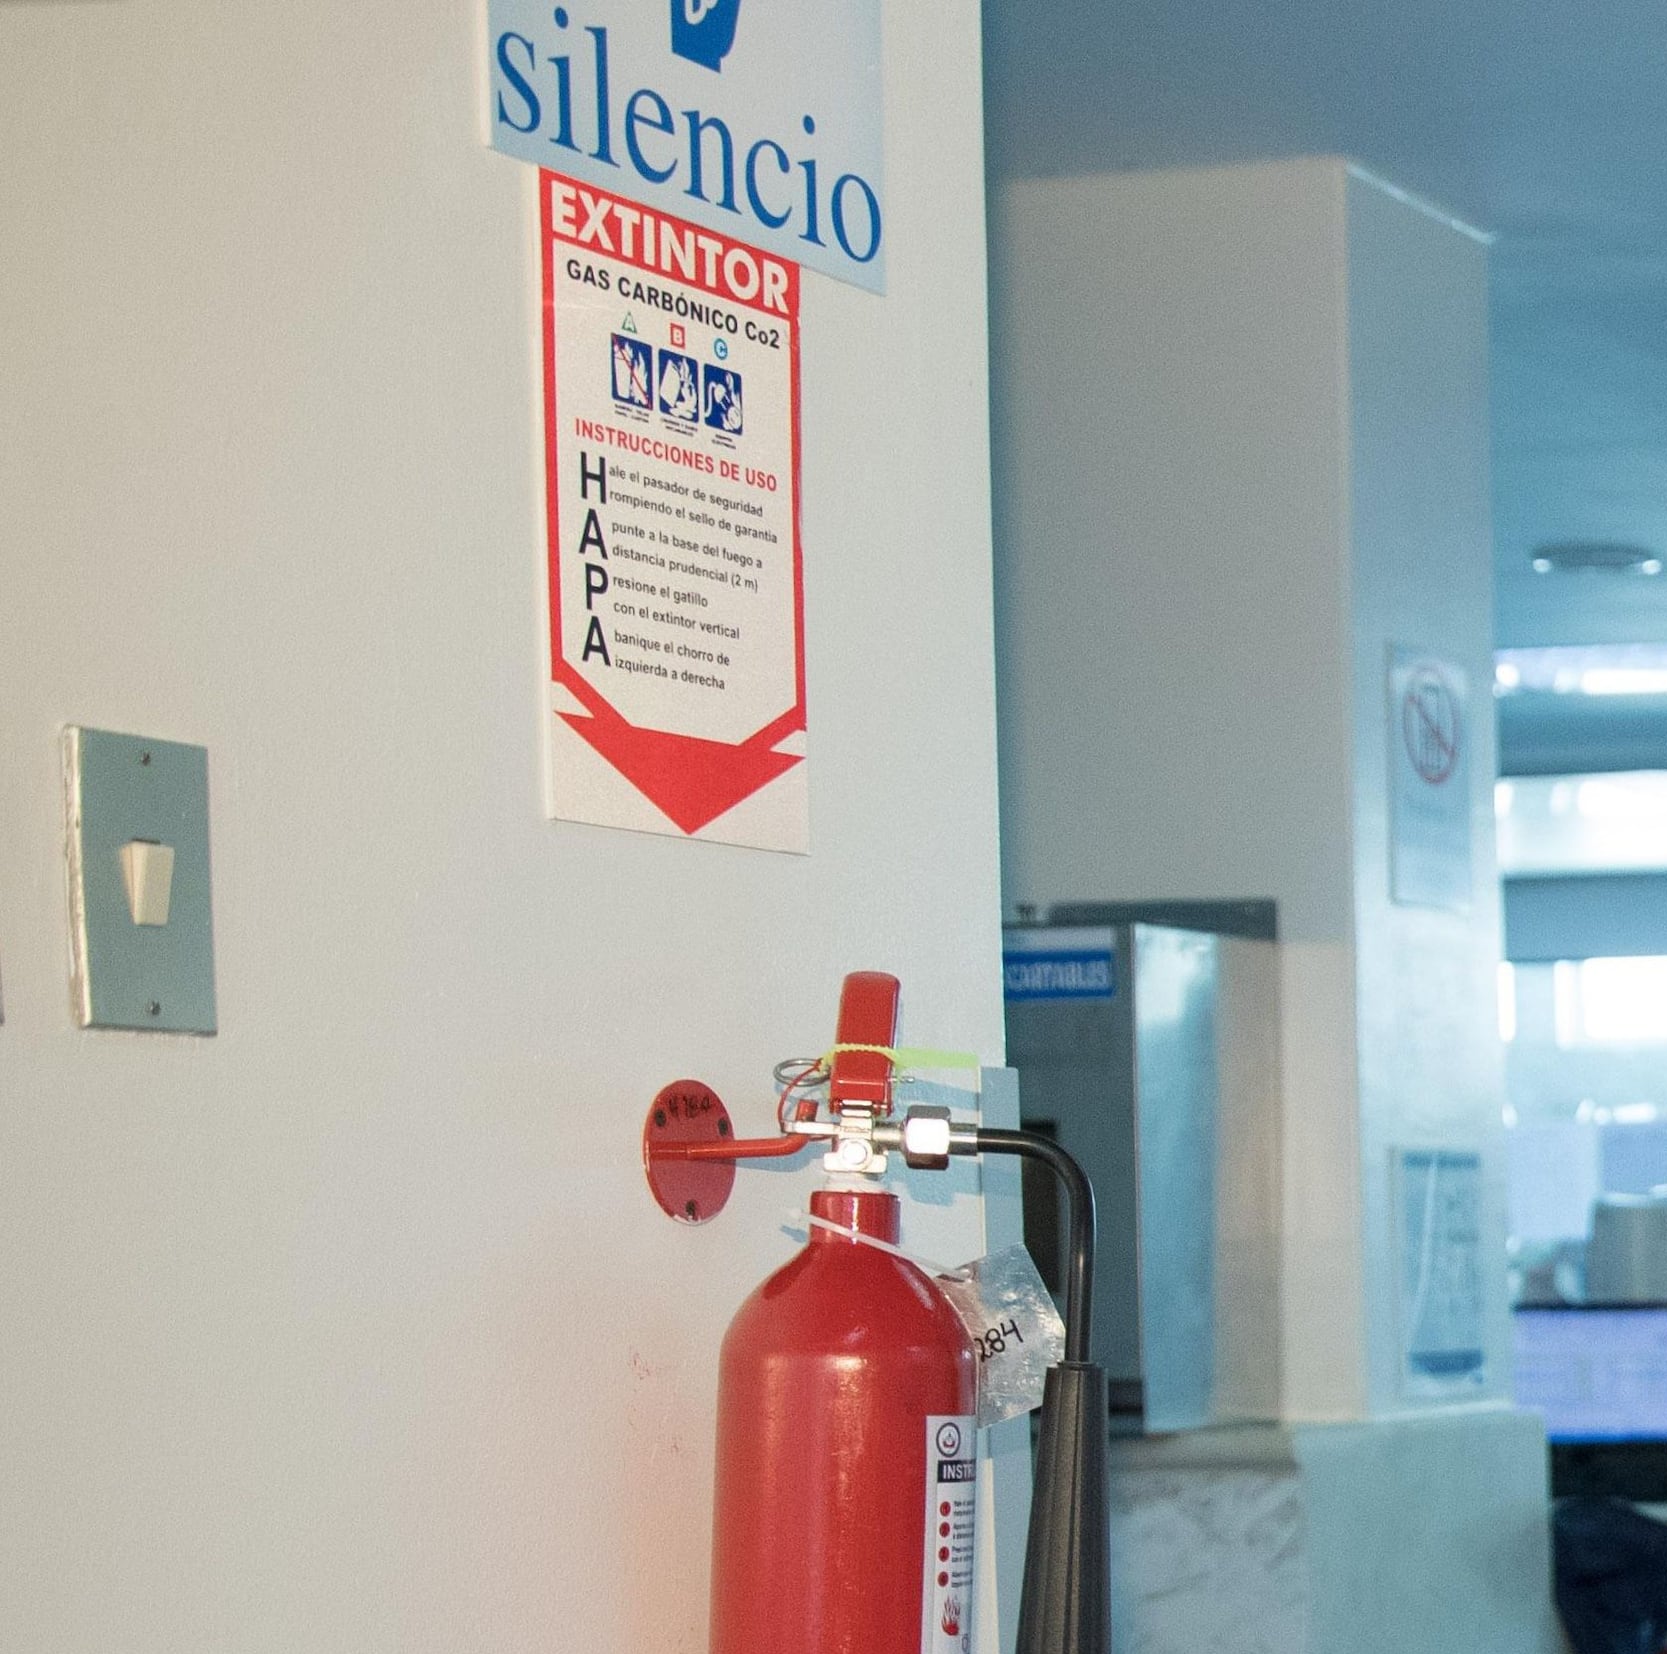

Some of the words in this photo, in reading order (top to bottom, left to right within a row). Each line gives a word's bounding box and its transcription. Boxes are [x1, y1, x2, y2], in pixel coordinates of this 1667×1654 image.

[496, 7, 882, 265] silencio
[551, 180, 790, 316] EXTINTOR
[566, 258, 611, 290] GAS
[618, 276, 738, 334] CARBÓNICO
[744, 320, 781, 349] Co2
[575, 418, 714, 473] INSTRUCCIONES
[720, 460, 739, 481] DE
[745, 467, 777, 492] USO
[580, 451, 607, 505] H
[609, 465, 626, 480] ale
[629, 471, 640, 483] el
[643, 476, 690, 497] pasador
[692, 487, 706, 501] de
[709, 493, 763, 518] seguridad
[609, 490, 672, 515] rompiendo
[675, 506, 686, 519] el
[689, 511, 715, 527] sello
[718, 518, 732, 532] de
[578, 508, 608, 560] A
[612, 520, 645, 539] punte
[648, 531, 656, 541] a
[659, 531, 669, 545] la
[672, 534, 699, 553] base
[702, 541, 719, 557] del
[722, 546, 754, 568] fuego
[755, 559, 763, 569] a
[584, 562, 609, 611] P
[612, 544, 666, 568] distancia
[668, 559, 728, 583] prudencial
[730, 573, 742, 588] (2
[744, 577, 759, 593] m)
[613, 576, 656, 596] resione
[659, 586, 670, 598] el
[673, 590, 709, 608] gatillo
[581, 615, 611, 667] A
[613, 602, 635, 616] con
[638, 606, 649, 619] el
[652, 611, 696, 629] extintor
[699, 620, 740, 639] vertical
[614, 629, 660, 652] banique
[663, 640, 674, 653] el
[677, 643, 713, 663] chorro
[716, 651, 730, 666] de
[614, 655, 668, 678] izquierda
[671, 668, 678, 680] a
[681, 669, 725, 690] derecha
[973, 1318, 1024, 1363] 284
